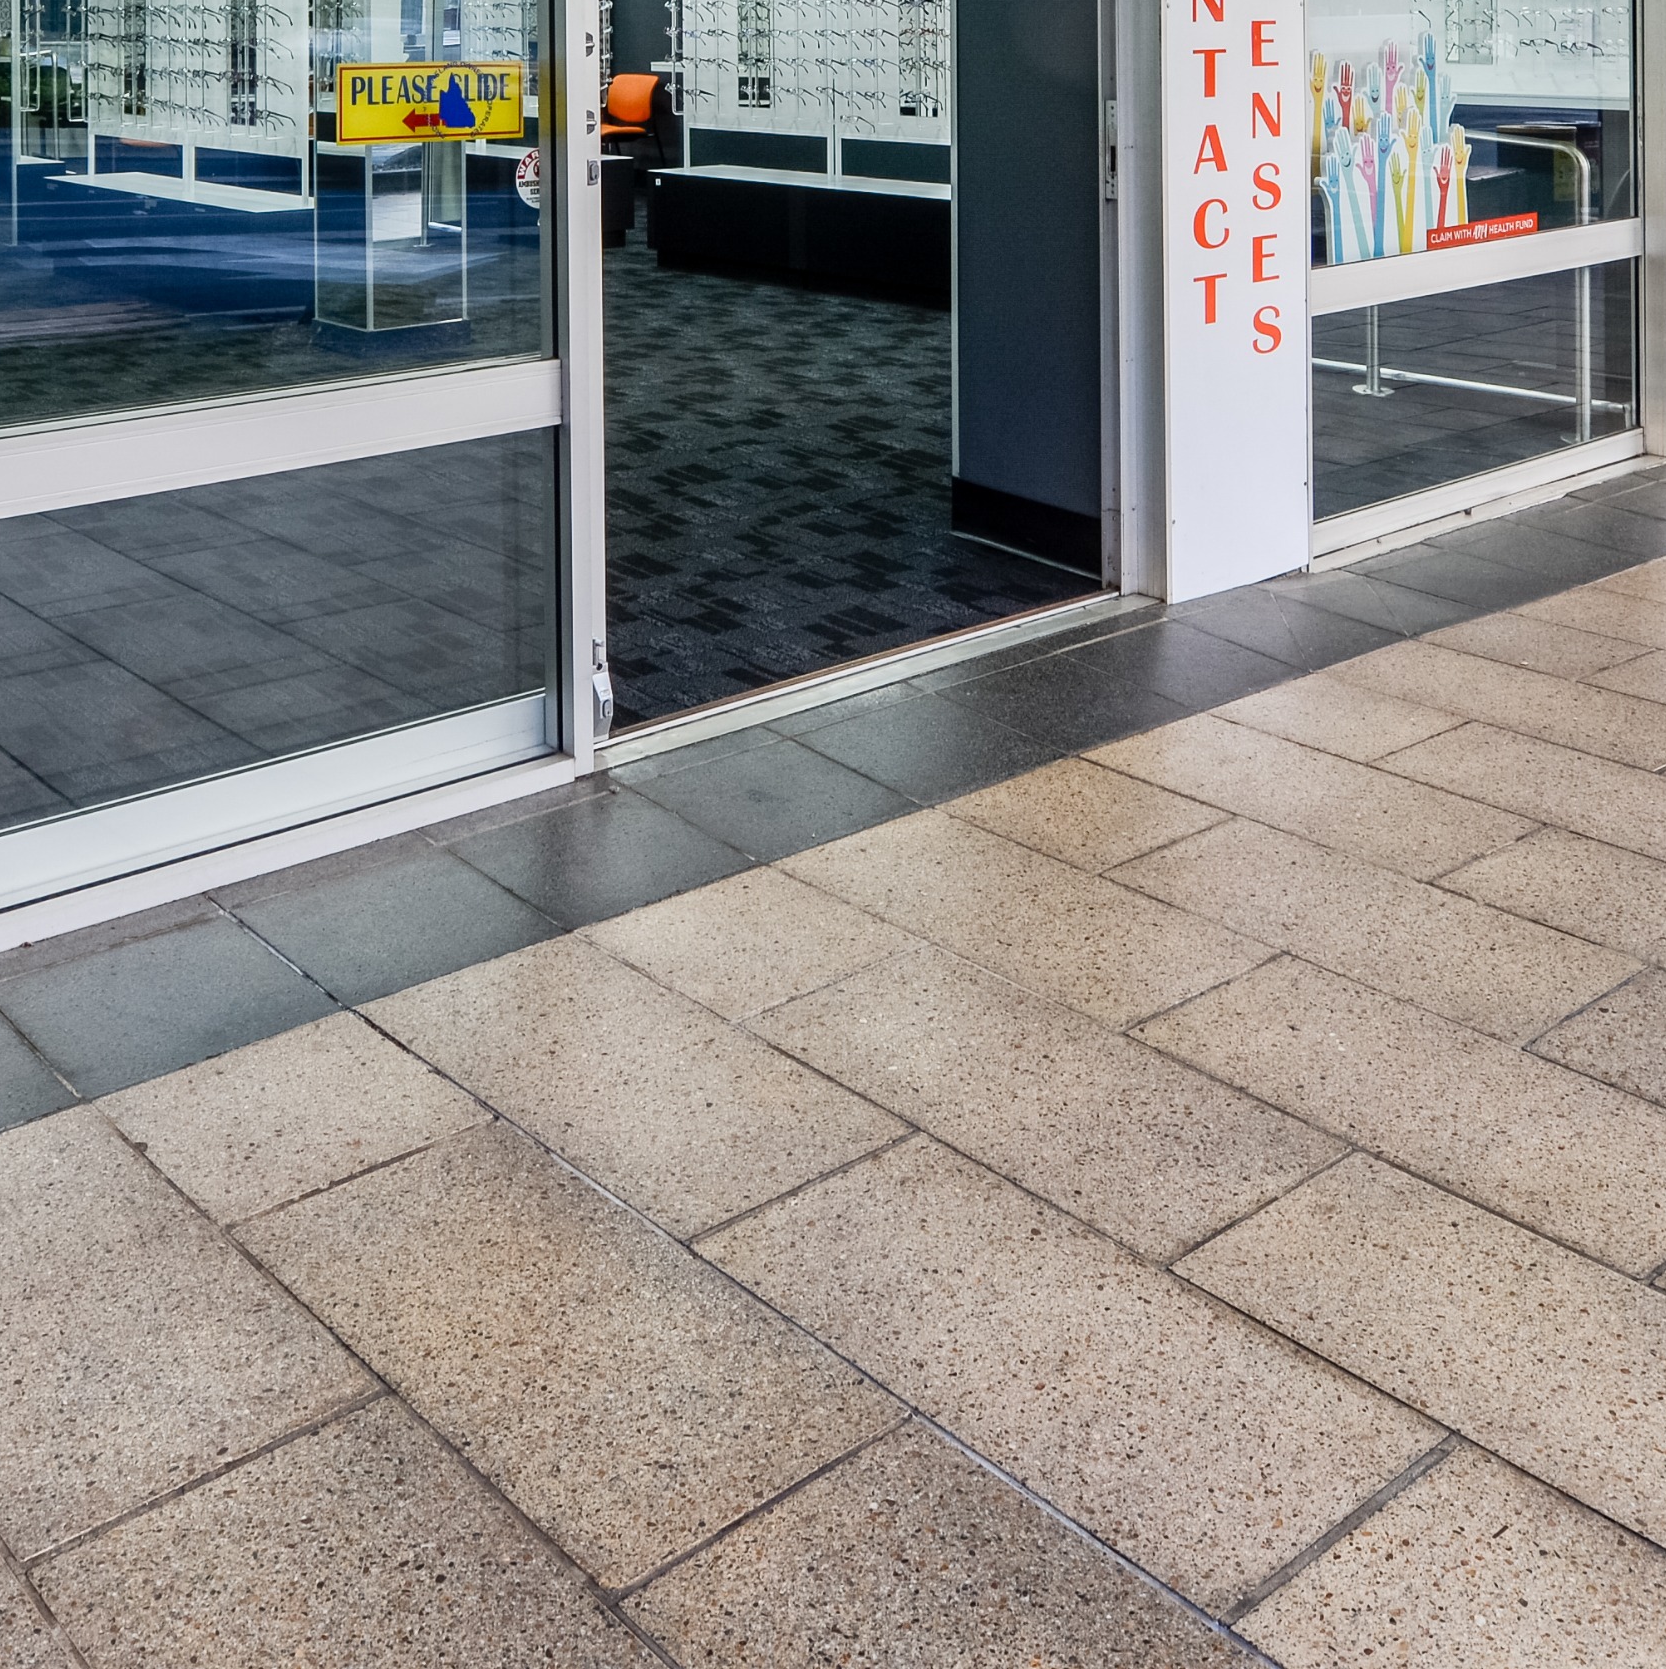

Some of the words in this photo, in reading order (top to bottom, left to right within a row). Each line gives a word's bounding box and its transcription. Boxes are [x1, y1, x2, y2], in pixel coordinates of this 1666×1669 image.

[351, 75, 438, 105] PLEASE
[1430, 232, 1453, 244] CLAIM
[1454, 229, 1472, 240] WITH
[1488, 222, 1514, 235] HEALTH
[1515, 219, 1534, 230] FUND
